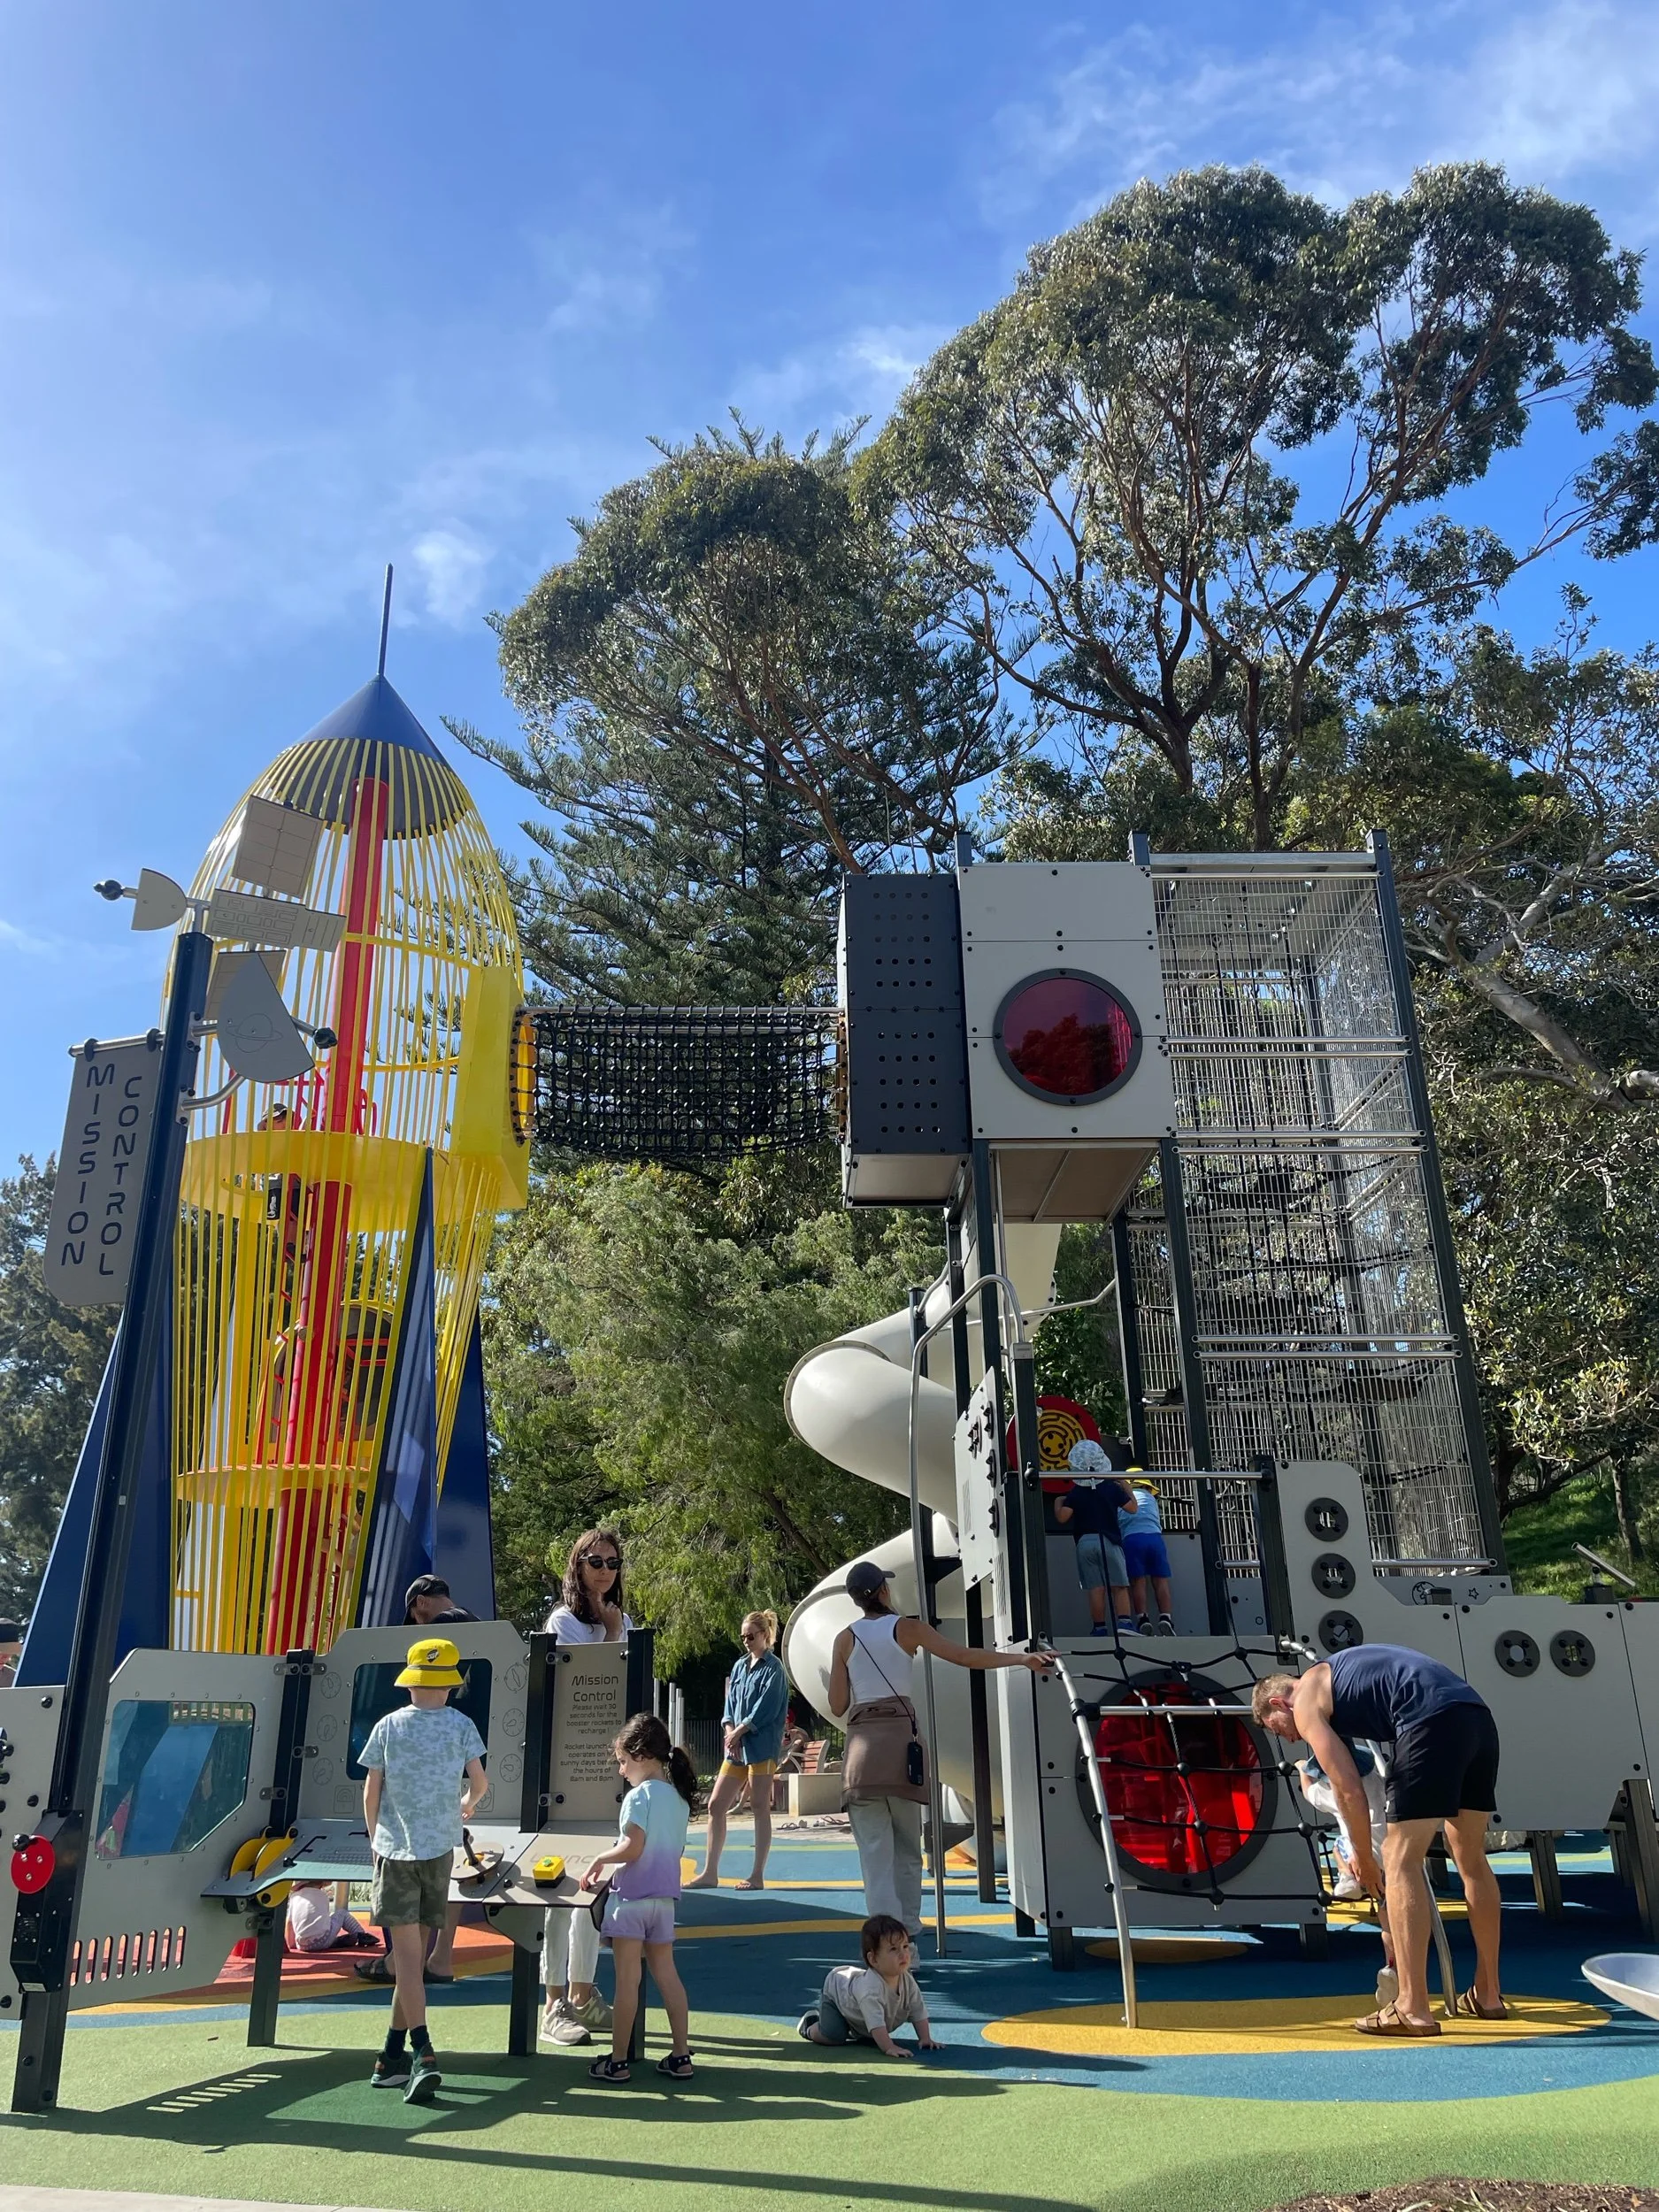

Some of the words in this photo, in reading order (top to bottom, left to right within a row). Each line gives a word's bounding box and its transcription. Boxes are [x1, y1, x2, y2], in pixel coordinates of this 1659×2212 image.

[61, 1063, 116, 1267] MISSION
[98, 1075, 142, 1276] CONTROL
[572, 1674, 619, 1686] Mission
[572, 1689, 617, 1702] Control
